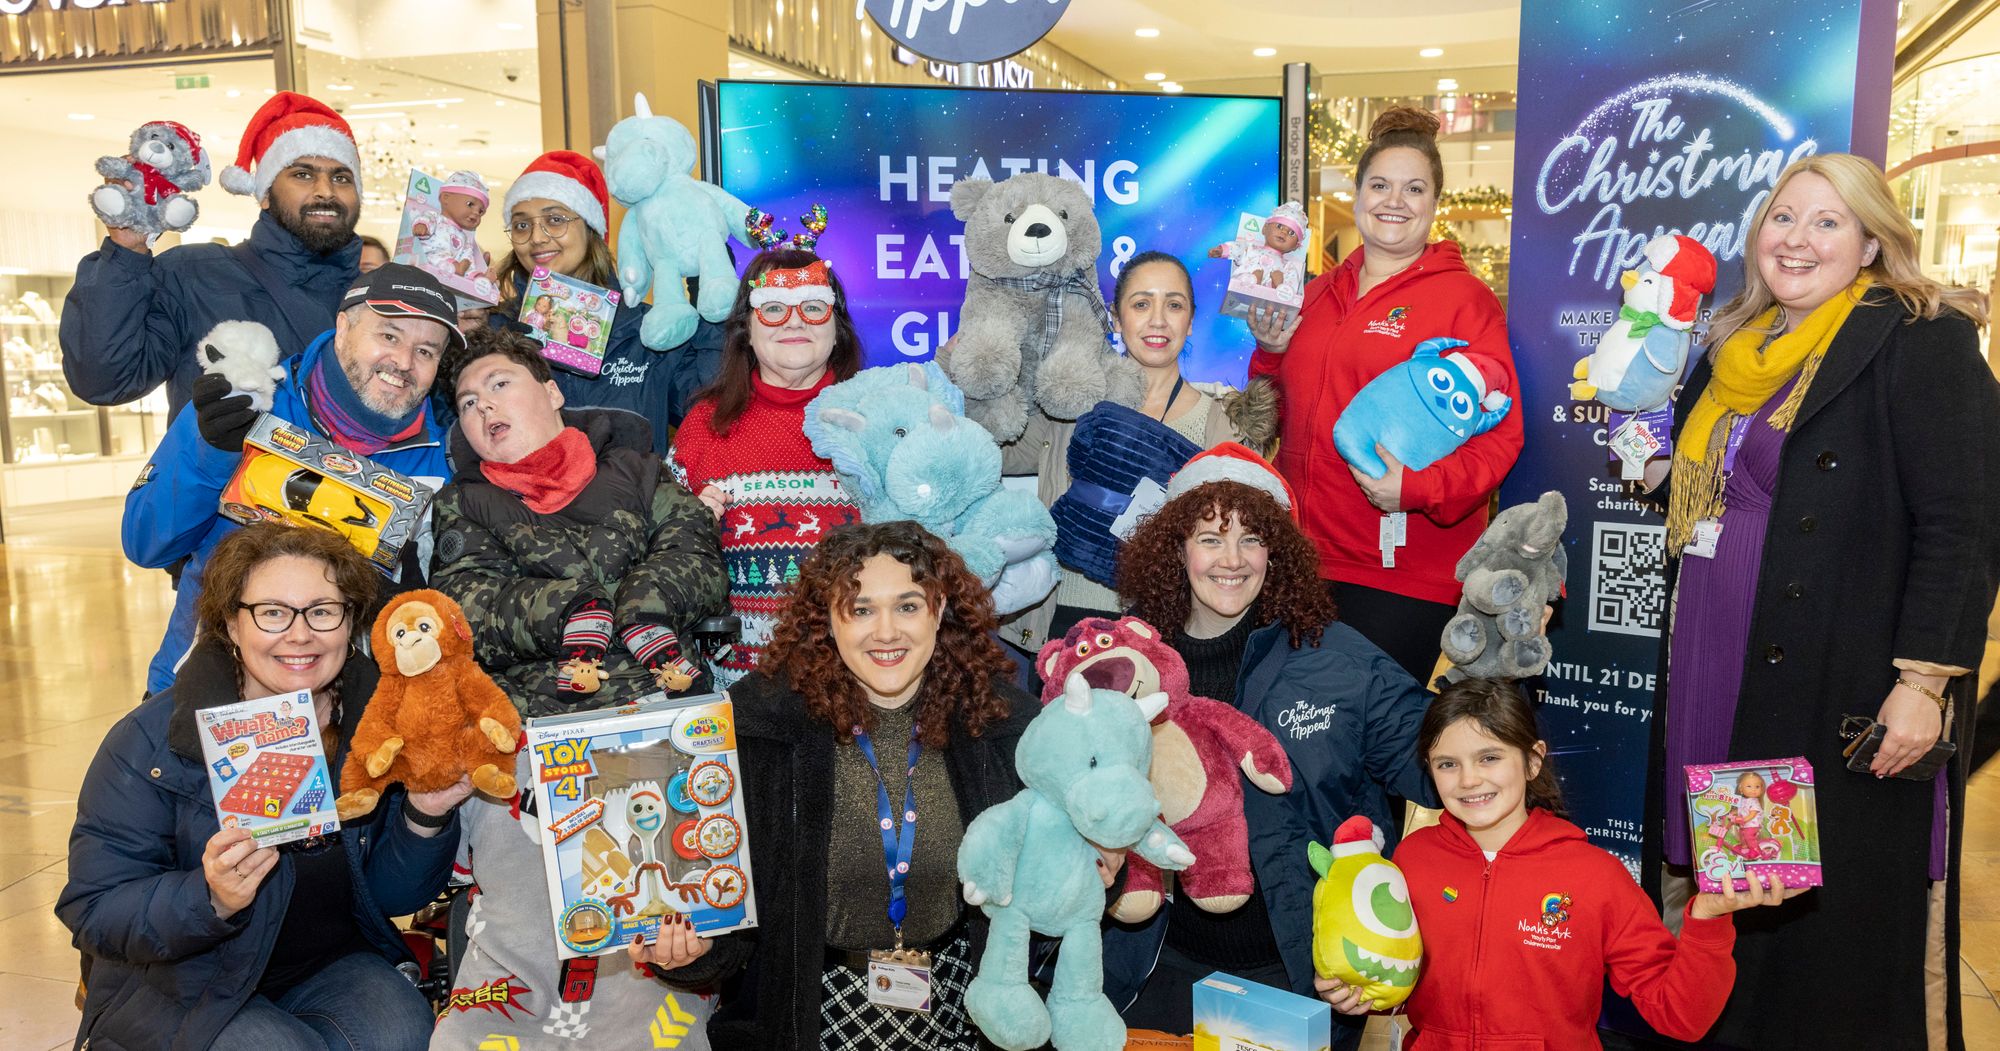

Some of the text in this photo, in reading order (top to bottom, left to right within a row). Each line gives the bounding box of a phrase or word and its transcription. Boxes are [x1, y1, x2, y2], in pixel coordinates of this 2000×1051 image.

[1631, 98, 1685, 148] The
[1288, 117, 1301, 156] Bridge
[1289, 158, 1301, 193] Street
[1569, 190, 1771, 290] Apeal
[1560, 311, 1612, 325] MAKE
[600, 361, 650, 376] Christmas
[617, 357, 629, 366] The
[609, 372, 645, 387] Appeal
[1552, 404, 1567, 423] &
[271, 433, 301, 452] POWER
[743, 478, 816, 492] SEASON
[1588, 477, 1624, 493] Scan
[1597, 495, 1650, 517] charity
[744, 620, 755, 630] LA
[1546, 661, 1593, 683] NTIL
[1600, 668, 1620, 687] 21
[1295, 700, 1309, 712] The
[1536, 689, 1580, 708] Thank
[1583, 699, 1609, 714] you
[1615, 701, 1636, 716] for
[1277, 704, 1337, 727] Christmas
[536, 727, 586, 740] Disney PIXAR
[685, 719, 728, 737] dough
[1290, 714, 1331, 741] Appeal
[535, 738, 591, 767] TOY
[544, 763, 587, 778] STORY
[556, 775, 580, 800] 4
[1607, 818, 1635, 831] THIS
[1584, 827, 1644, 843] CHRISTM
[1517, 918, 1573, 940] Noah's Ark
[1131, 1038, 1190, 1048] NARNIA
